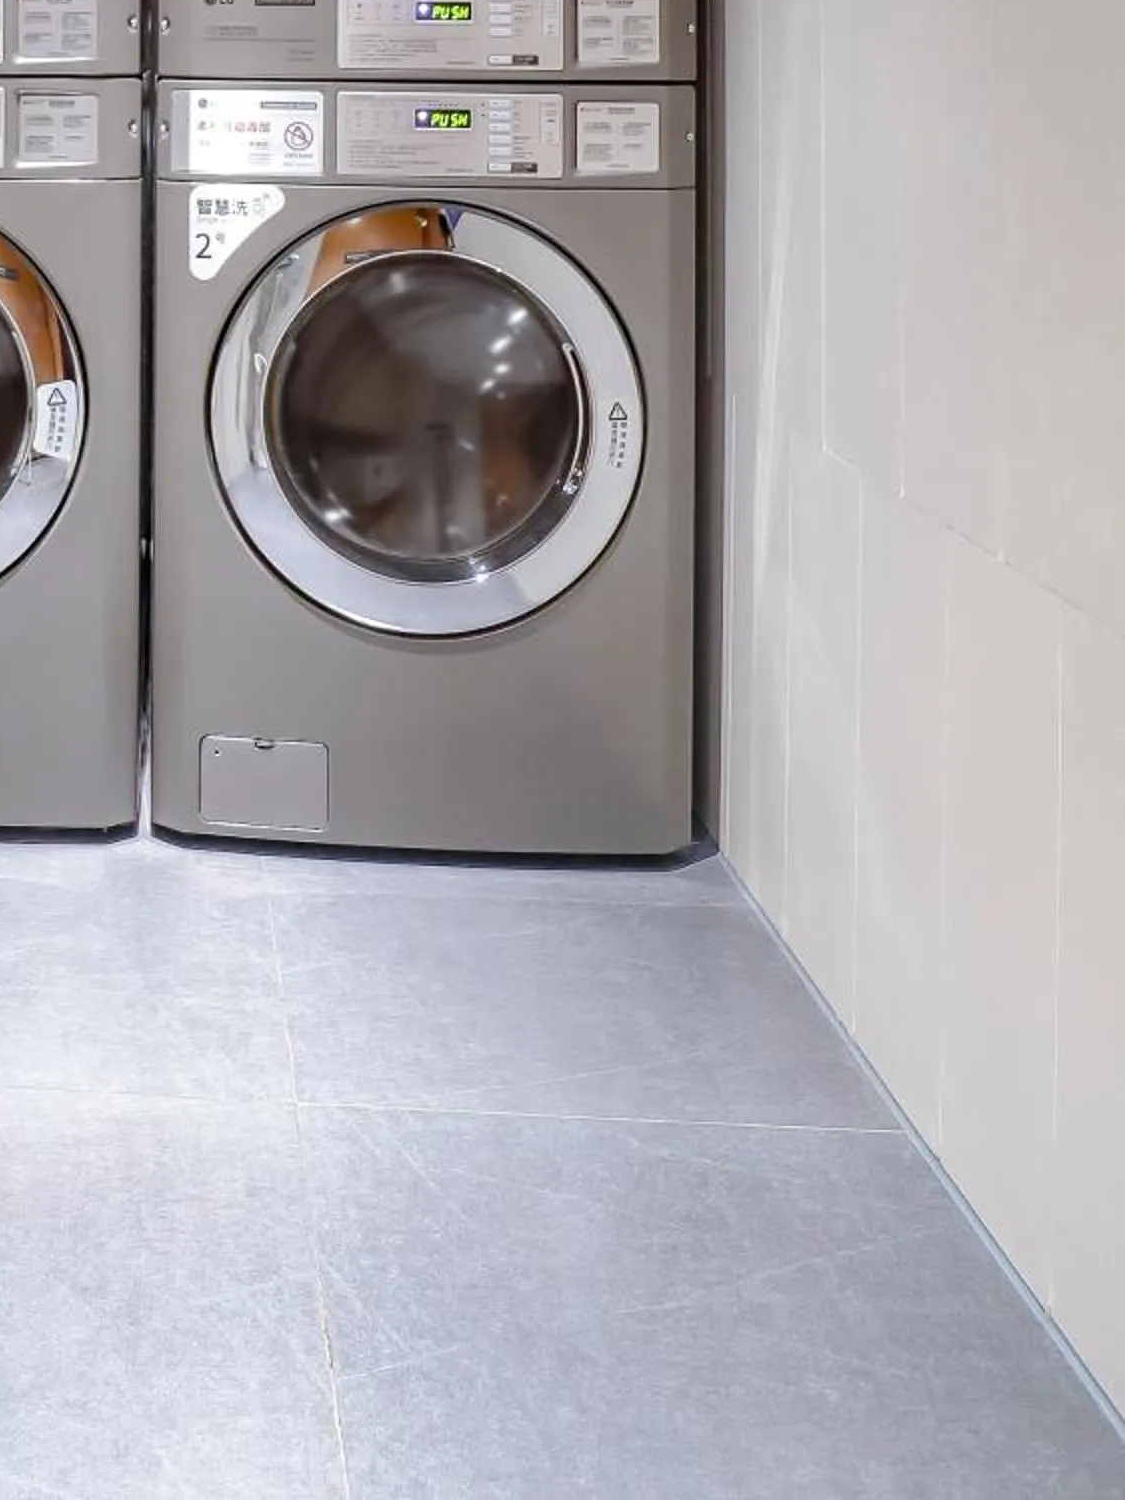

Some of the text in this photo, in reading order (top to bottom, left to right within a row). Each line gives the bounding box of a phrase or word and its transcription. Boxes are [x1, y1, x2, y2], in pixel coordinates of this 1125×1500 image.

[431, 5, 469, 19] PUSH
[431, 112, 468, 127] PUSH
[195, 233, 212, 258] 2
